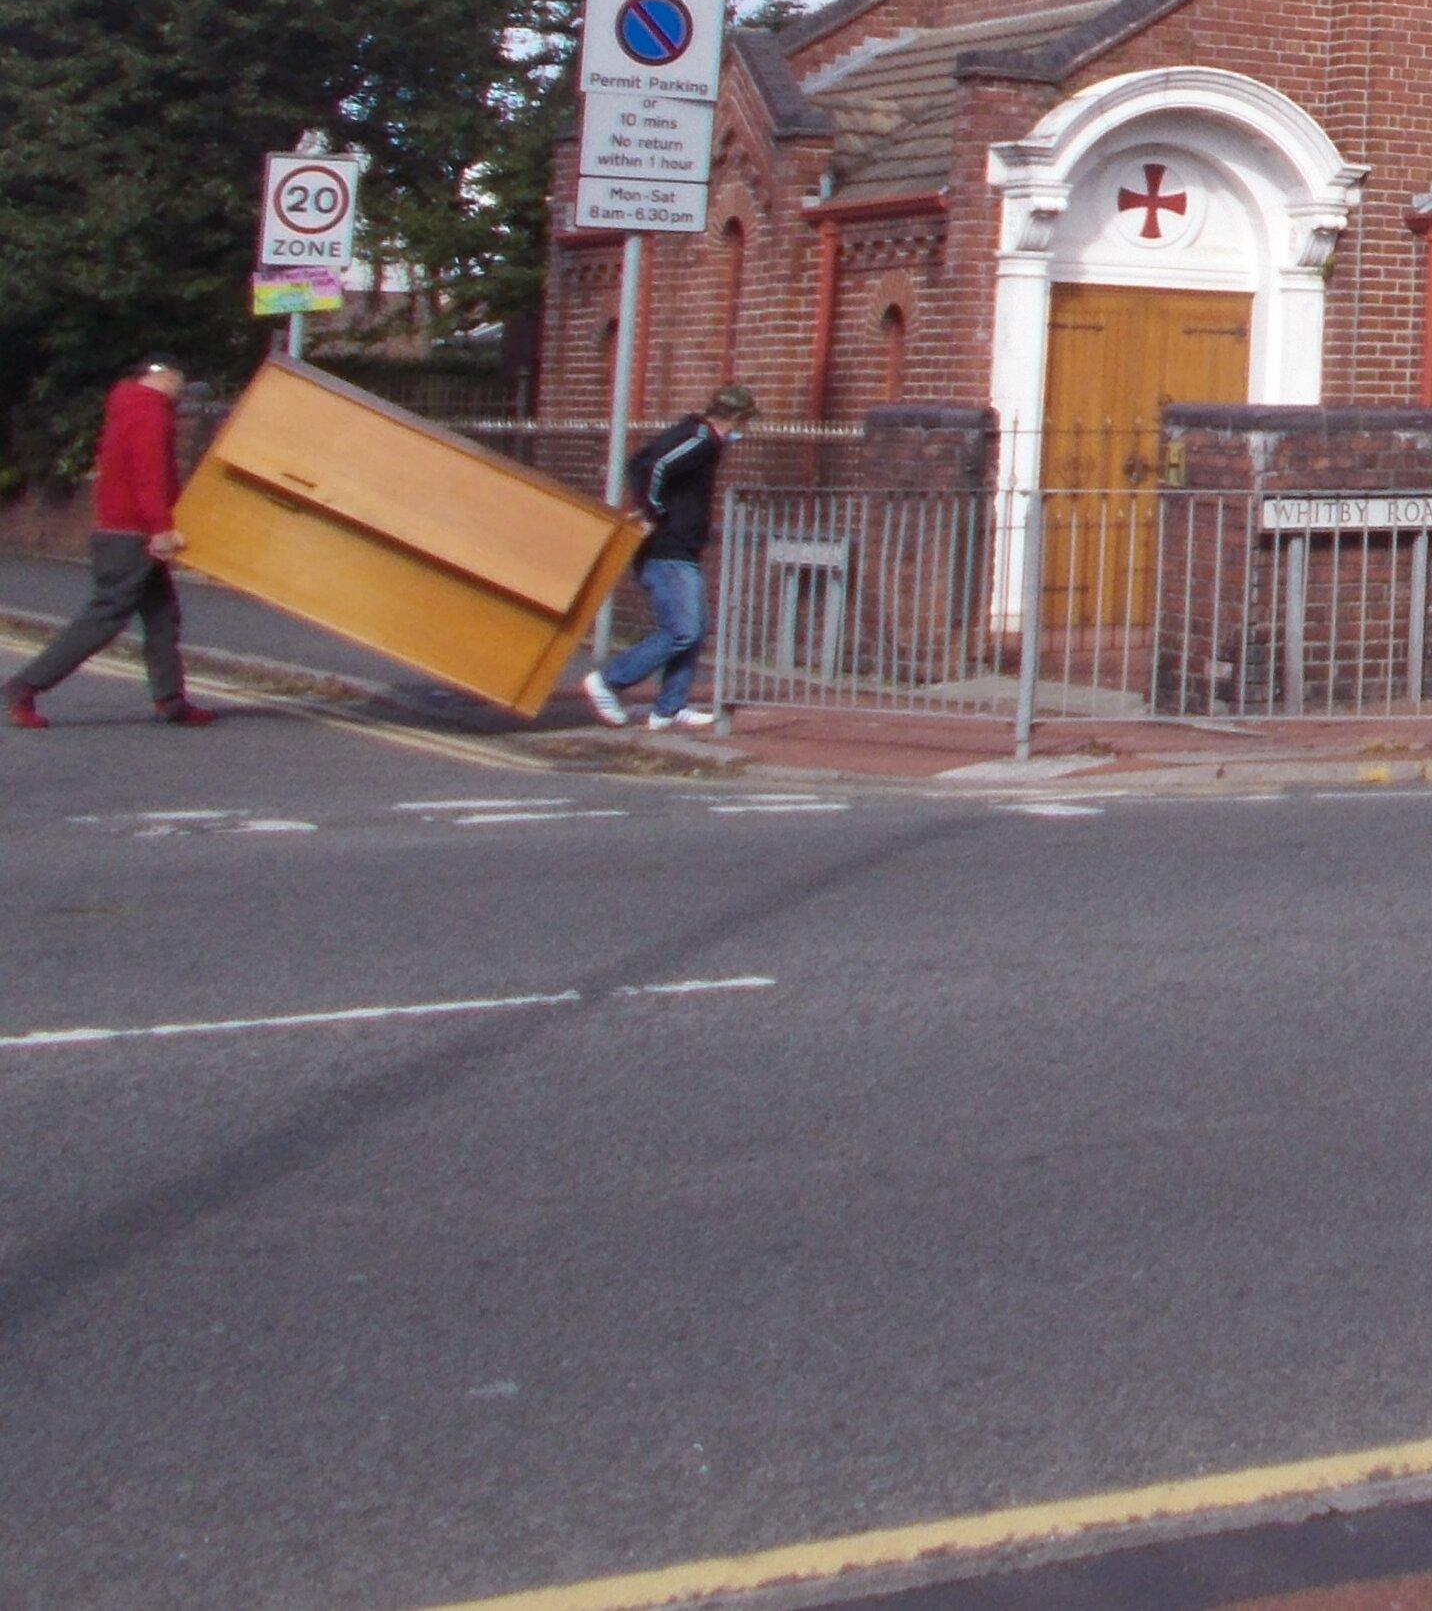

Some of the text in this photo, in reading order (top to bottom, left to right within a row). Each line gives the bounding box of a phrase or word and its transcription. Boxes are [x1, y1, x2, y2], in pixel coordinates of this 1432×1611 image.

[590, 73, 708, 95] Permit Parking
[643, 99, 657, 108] or
[621, 113, 678, 130] 10 mins
[611, 134, 683, 150] No return
[598, 153, 694, 170] within 1 hour
[286, 186, 338, 214] 20
[610, 188, 641, 202] Mon
[651, 189, 675, 203] Sat
[272, 239, 342, 258] ZONE
[1273, 501, 1368, 524] WHITBY
